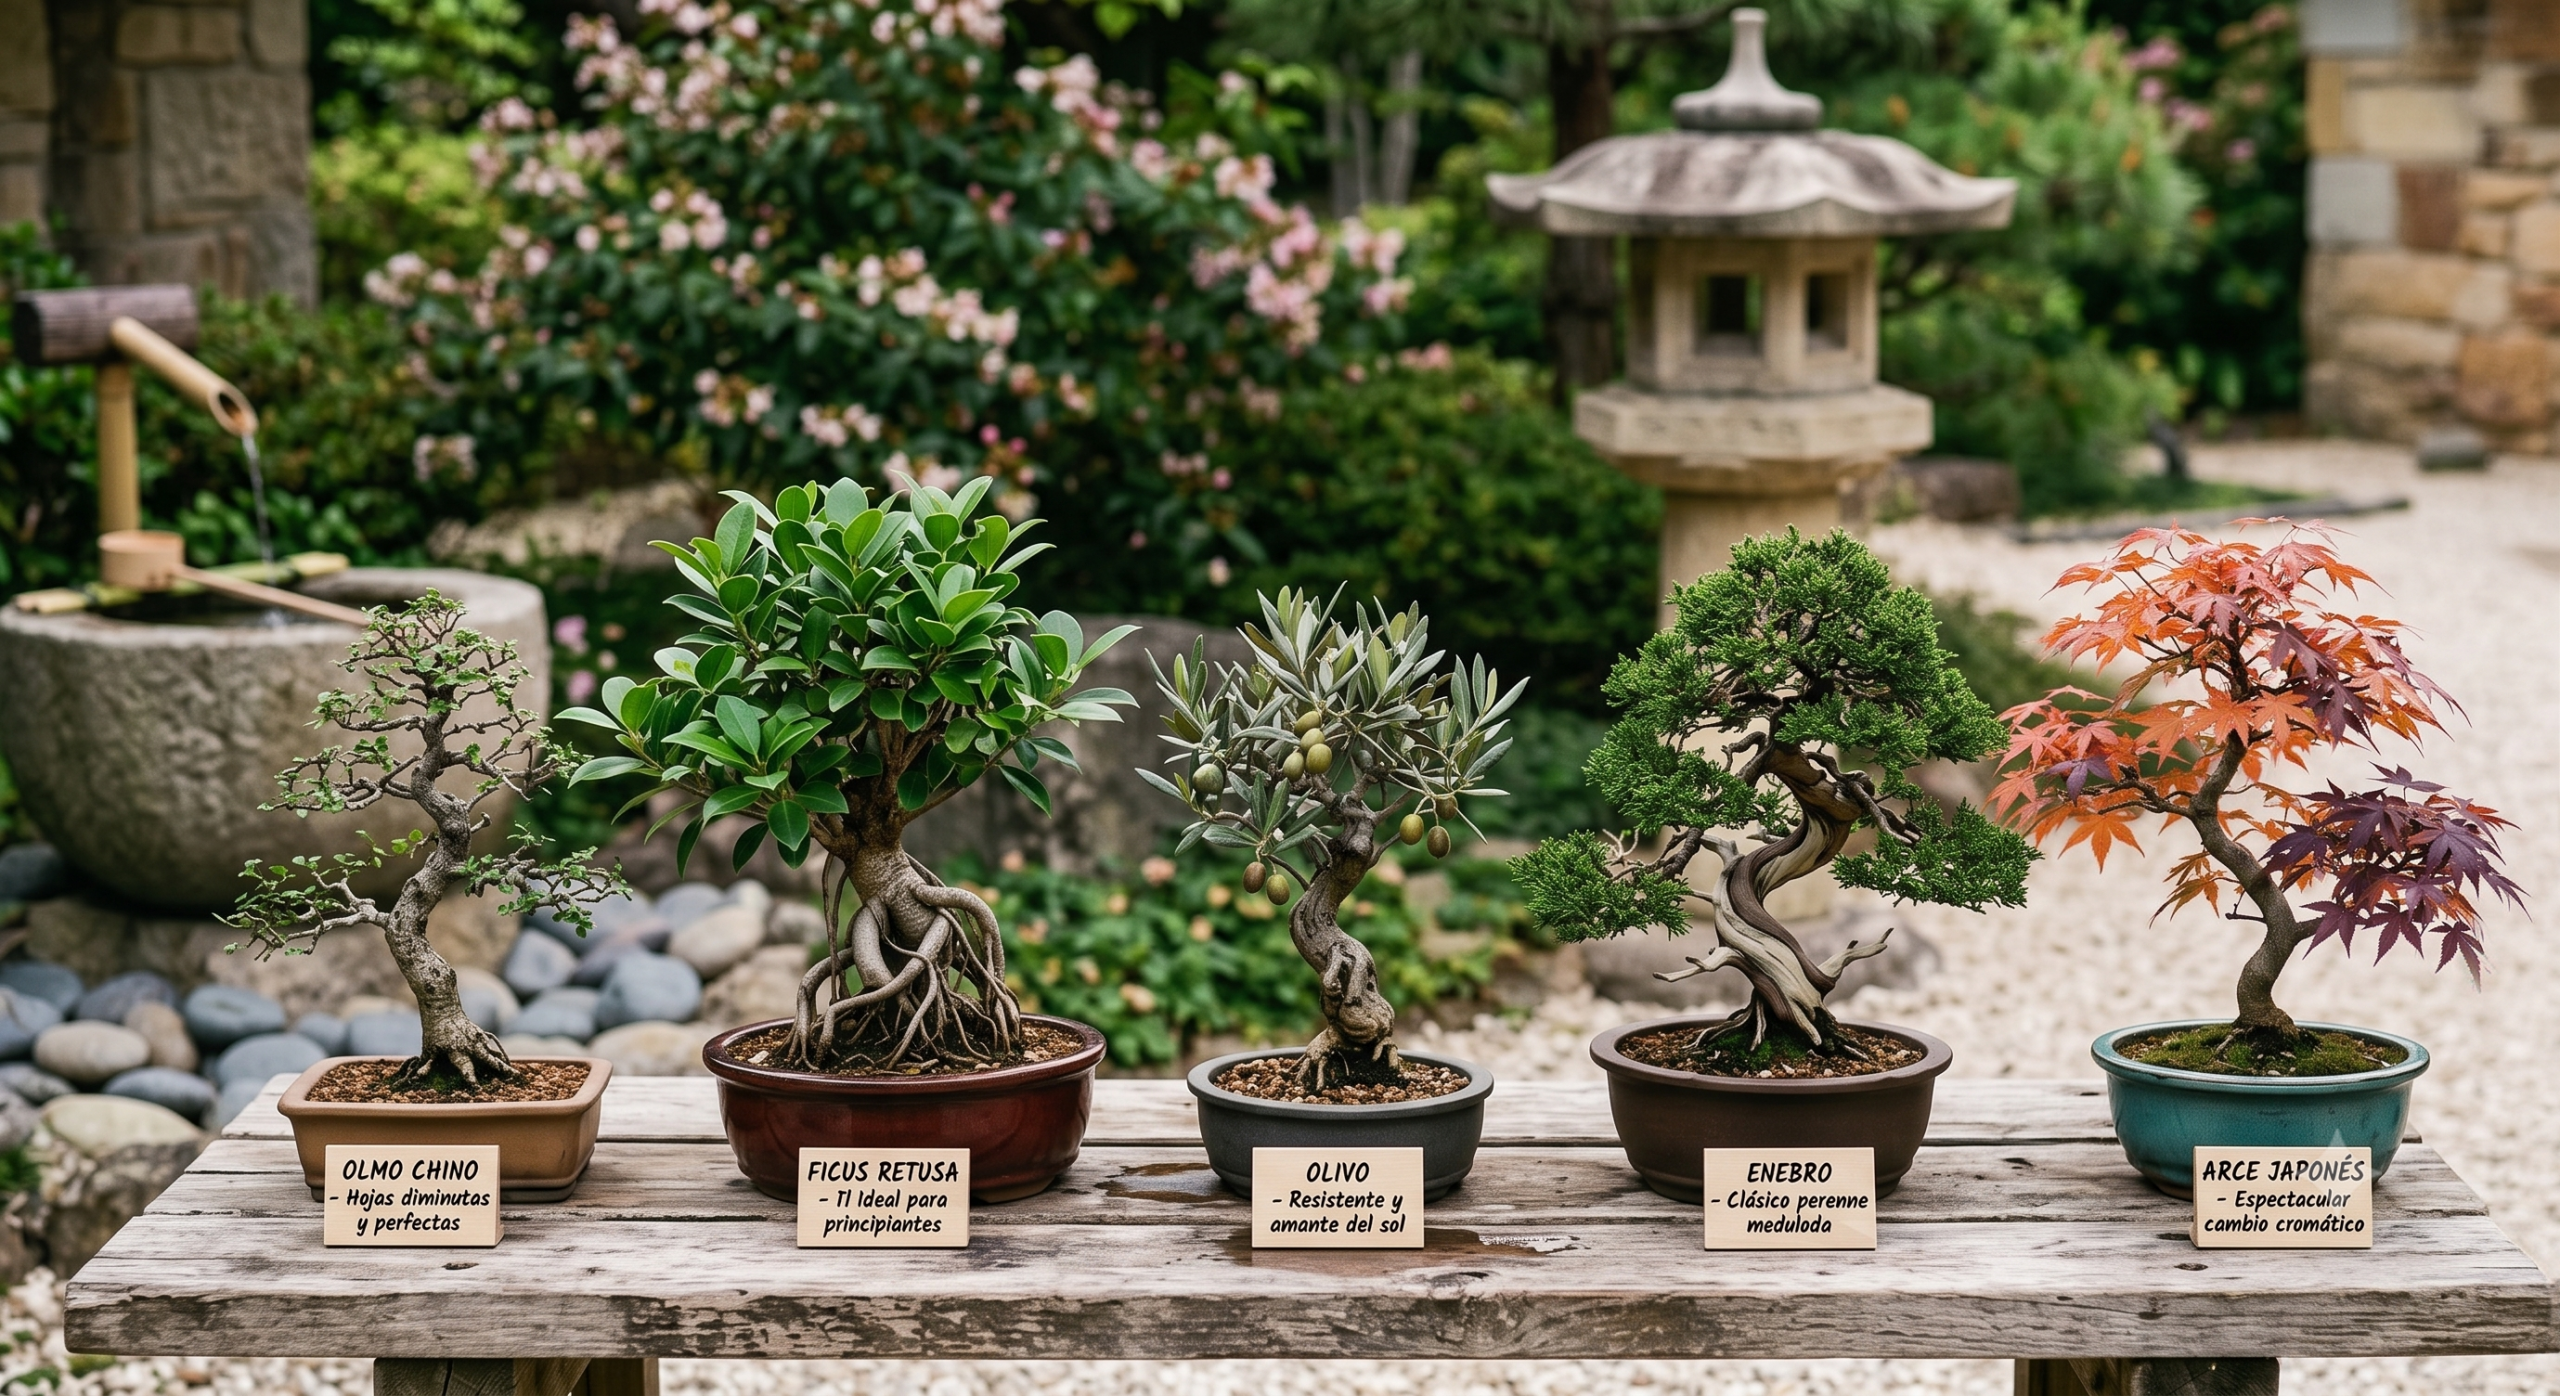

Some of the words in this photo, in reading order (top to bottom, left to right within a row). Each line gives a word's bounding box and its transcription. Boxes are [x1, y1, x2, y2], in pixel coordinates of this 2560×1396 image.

[342, 1159, 404, 1181] OLMO
[411, 1159, 479, 1181] CHINO
[807, 1160, 869, 1182] FICUS
[877, 1160, 959, 1183] RETUSA
[1306, 1161, 1370, 1183] OLIVO
[1747, 1161, 1833, 1184] ENEBRO
[2202, 1160, 2261, 1182] ARCE
[2267, 1153, 2365, 1182] JAPONÉS
[346, 1188, 395, 1213] Hojas
[400, 1186, 491, 1207] diminutas
[857, 1188, 901, 1208] Ideal
[905, 1194, 948, 1214] para
[1288, 1189, 1385, 1209] Resistente
[1390, 1194, 1404, 1215] y
[1726, 1189, 1791, 1209] Clásico
[1794, 1195, 1869, 1214] perenne
[2234, 1188, 2351, 1213] Espectacular
[356, 1217, 369, 1237] y
[373, 1211, 461, 1237] perfectas
[822, 1214, 942, 1239] principiantes
[1269, 1215, 1340, 1233] amante
[1345, 1213, 1374, 1233] del
[1379, 1213, 1406, 1233] sol
[1746, 1213, 1832, 1234] meduloda
[2204, 1213, 2269, 1233] cambio
[2275, 1213, 2365, 1233] cromático
